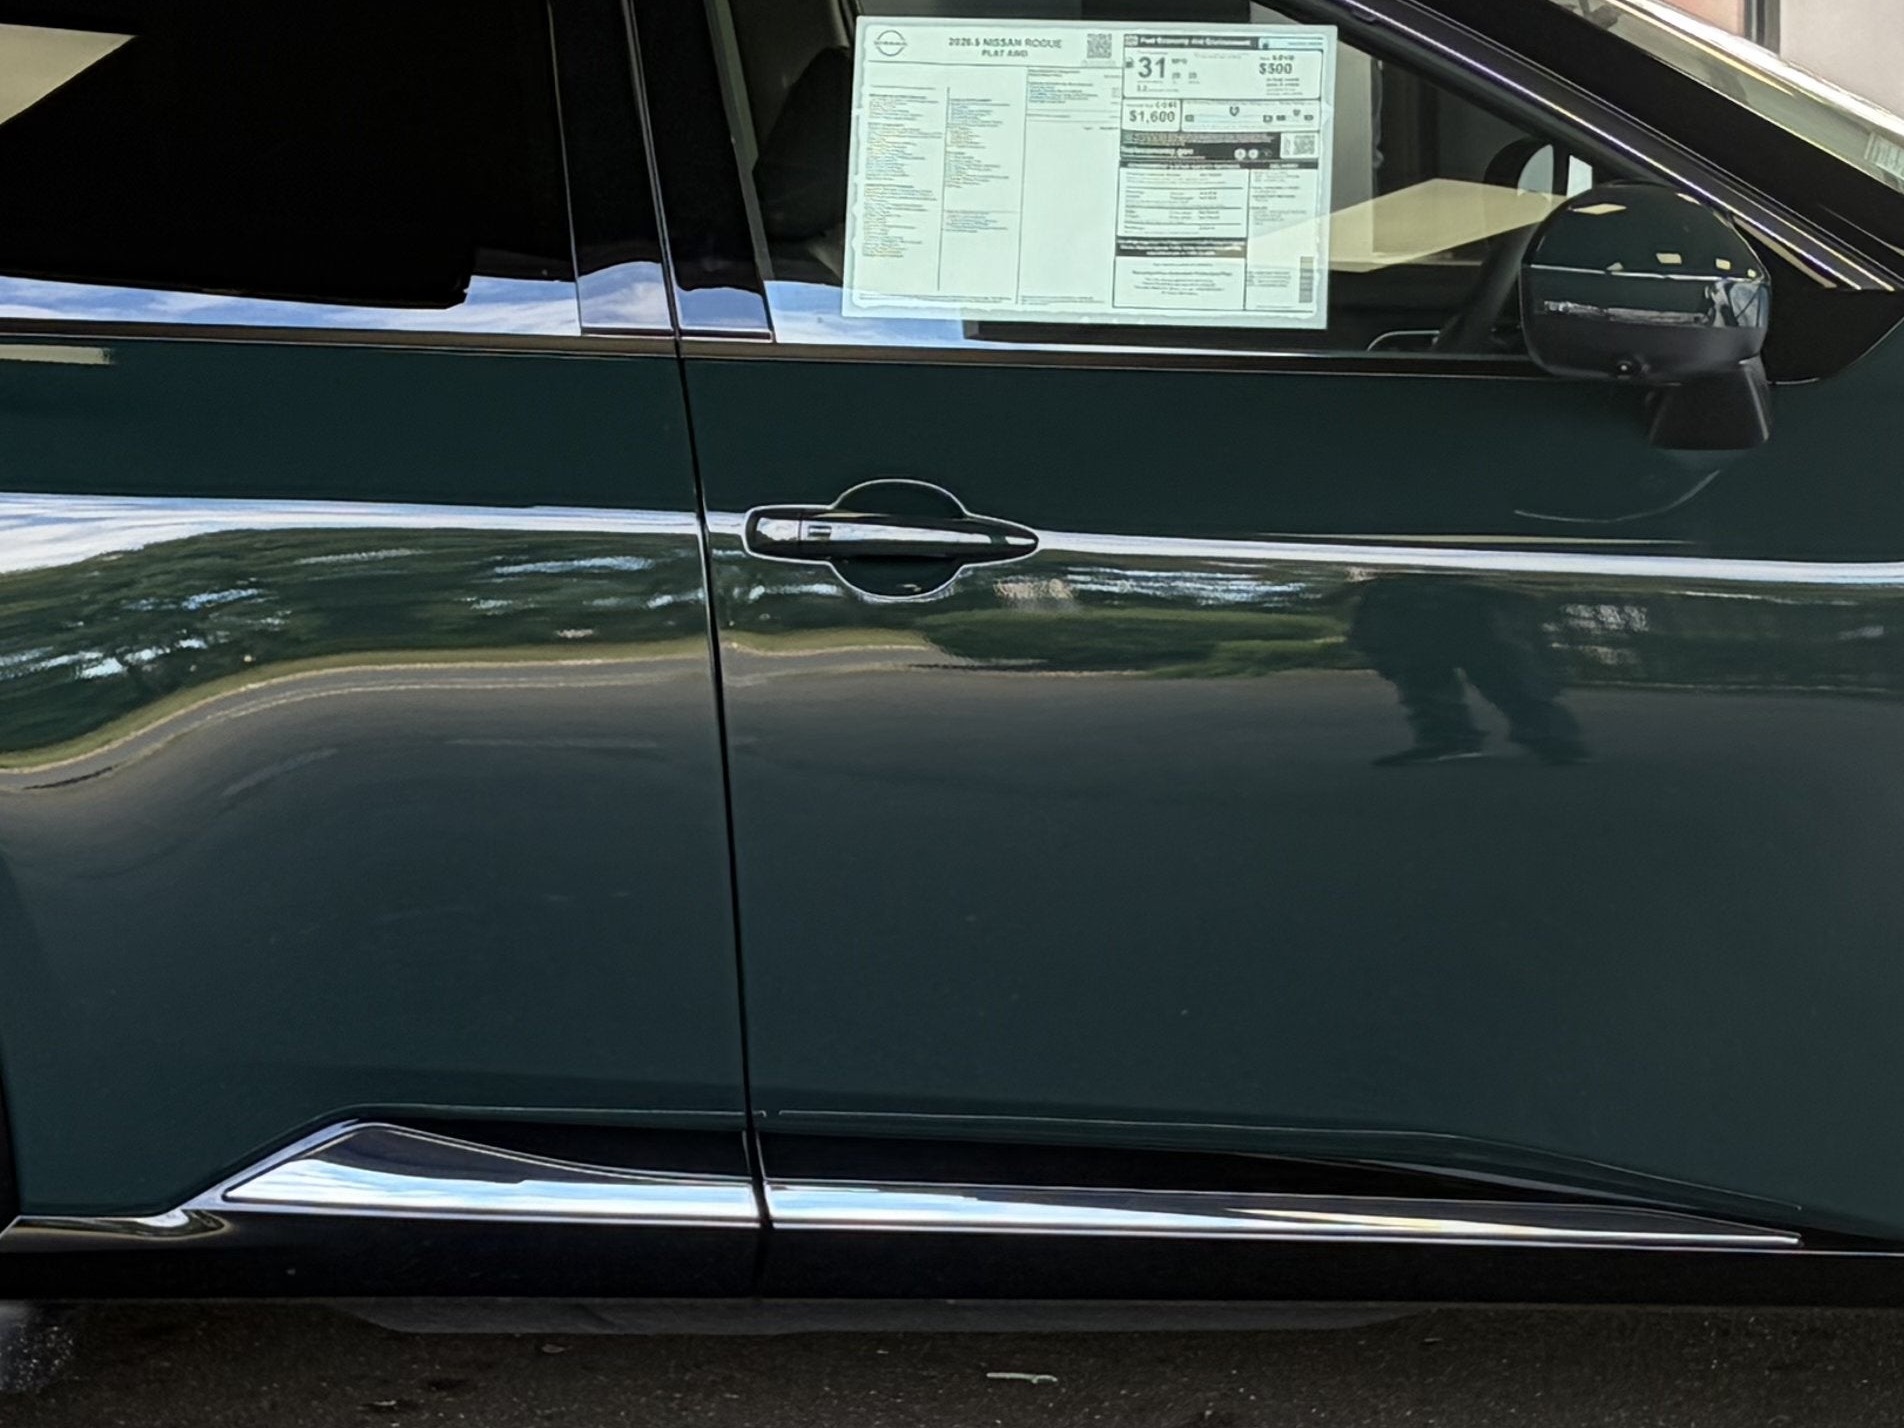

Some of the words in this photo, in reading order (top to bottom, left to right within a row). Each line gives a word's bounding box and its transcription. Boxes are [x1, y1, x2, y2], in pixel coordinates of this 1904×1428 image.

[982, 37, 1022, 48] NISSAN
[1024, 38, 1062, 49] ROGUE
[1137, 56, 1166, 79] 31
[1128, 109, 1176, 124] $1,600
